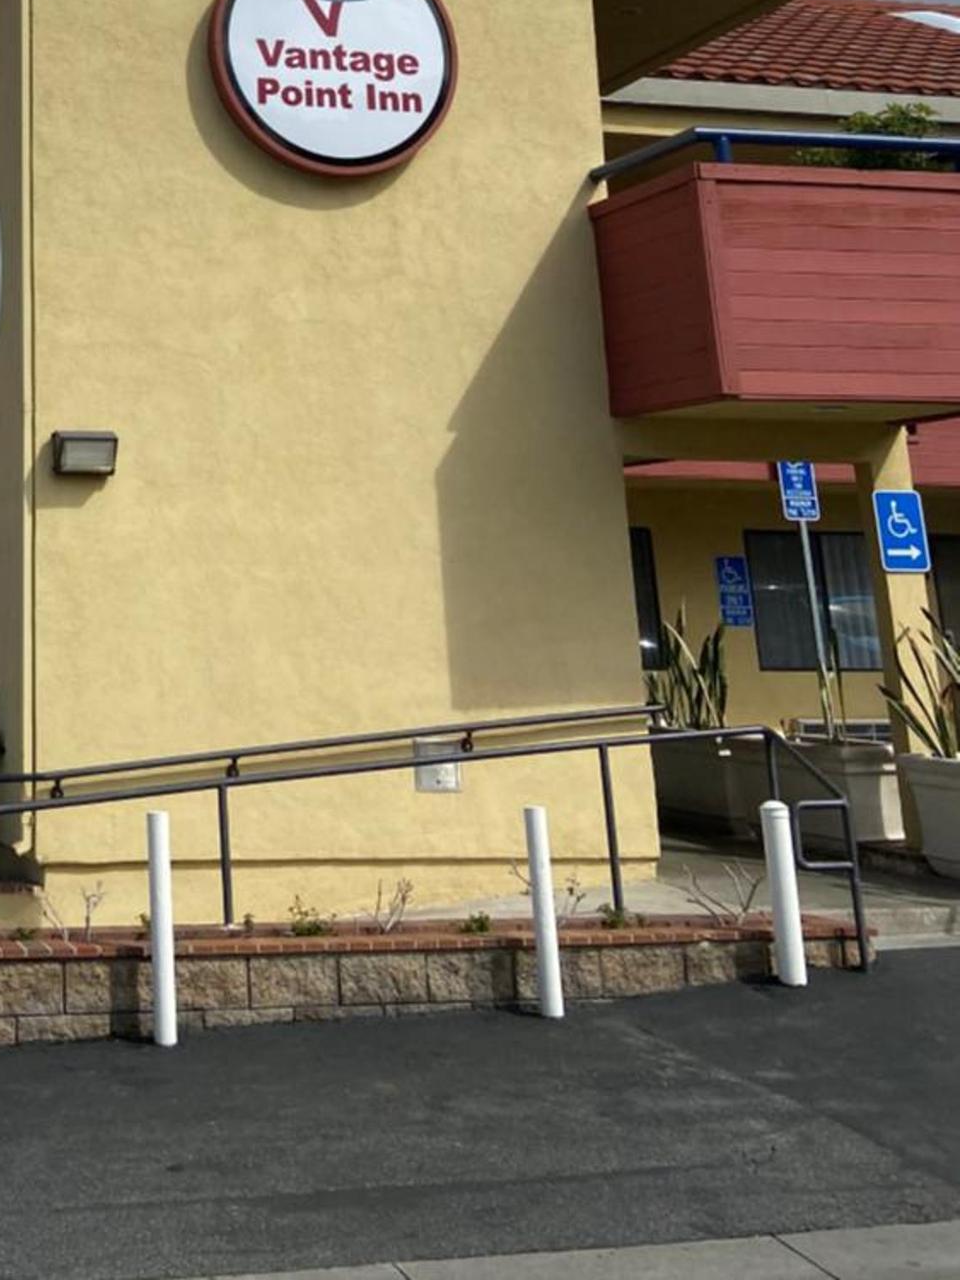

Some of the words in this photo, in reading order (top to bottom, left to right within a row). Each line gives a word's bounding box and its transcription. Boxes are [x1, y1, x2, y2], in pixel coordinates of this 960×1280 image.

[256, 38, 419, 81] Vantage
[257, 77, 353, 109] Point
[366, 84, 423, 113] Inn
